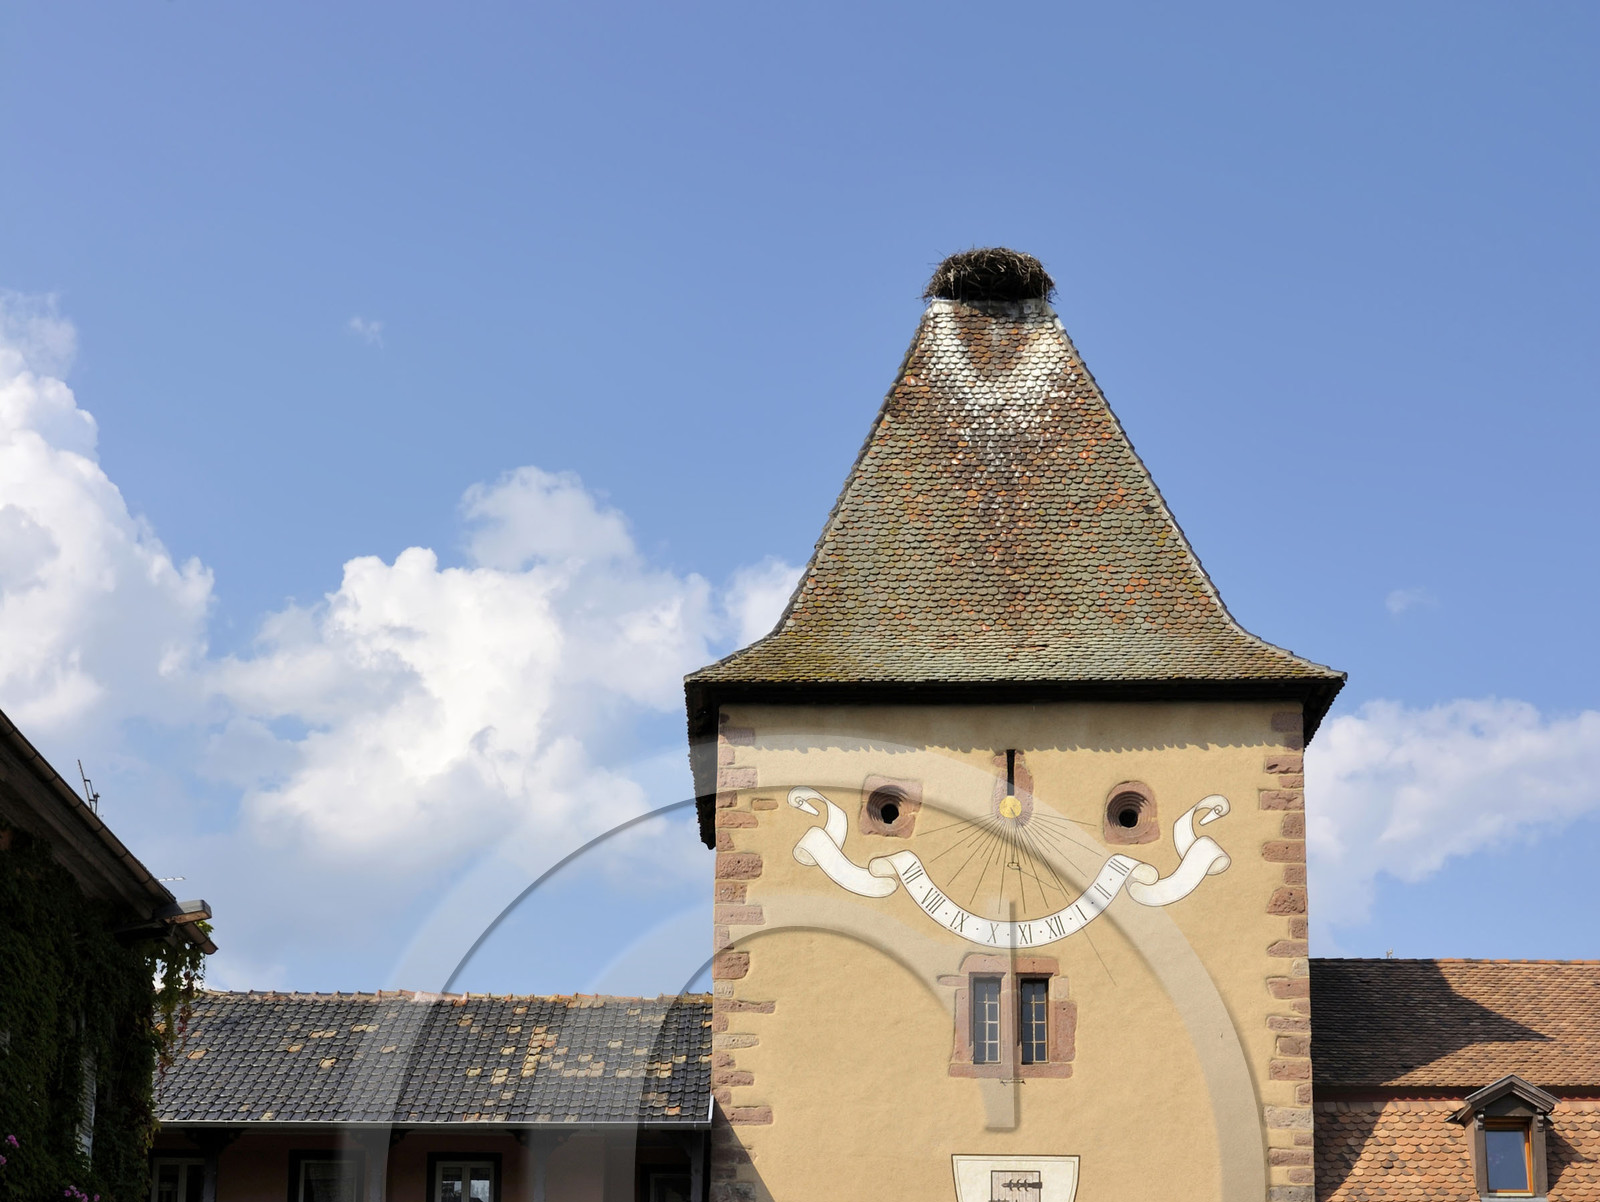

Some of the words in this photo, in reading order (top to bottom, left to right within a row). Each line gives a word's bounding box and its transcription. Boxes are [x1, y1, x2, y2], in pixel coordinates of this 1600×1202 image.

[902, 861, 923, 885] VII
[921, 888, 946, 915] VIII
[949, 911, 970, 933] IX
[987, 922, 999, 943] X
[1018, 924, 1033, 944] XI
[1045, 915, 1066, 939] XII
